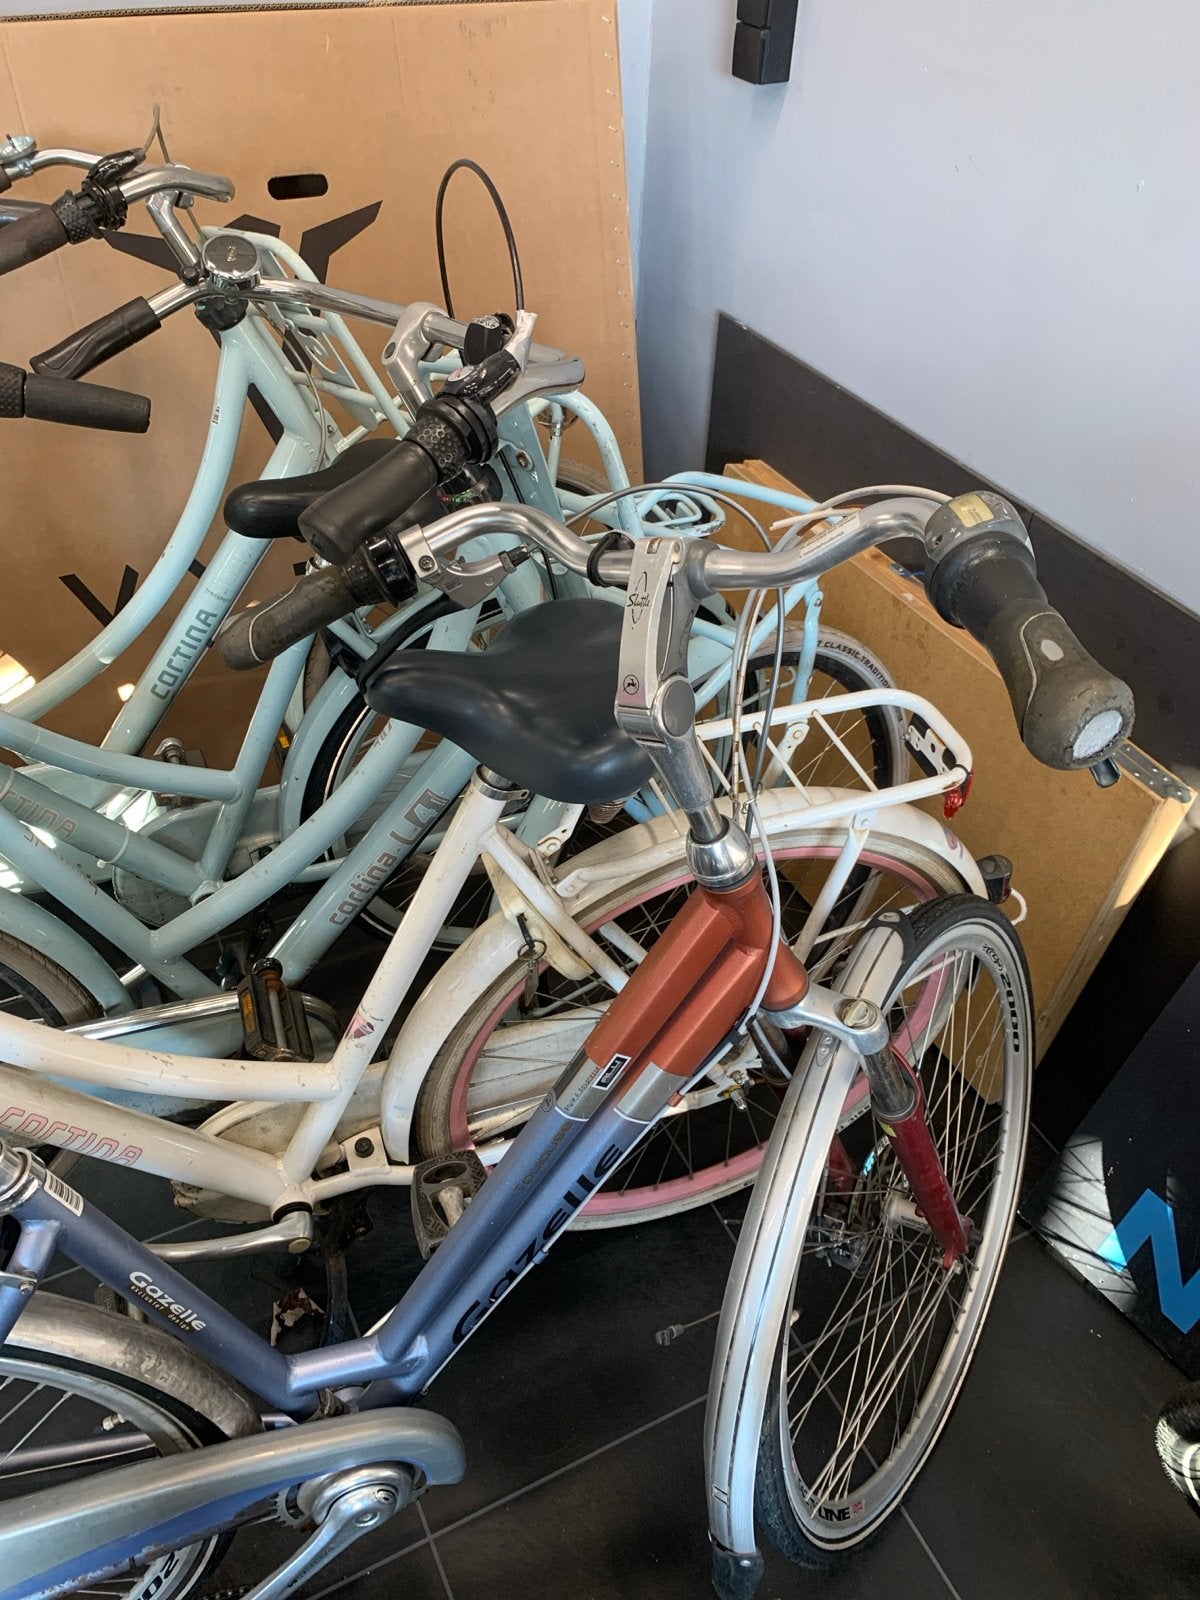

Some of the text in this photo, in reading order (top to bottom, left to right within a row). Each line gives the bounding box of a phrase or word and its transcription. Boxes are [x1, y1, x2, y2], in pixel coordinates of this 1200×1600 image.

[328, 851, 399, 926] cortina
[1000, 972, 1020, 1053] 2000
[129, 1271, 207, 1331] Gazelle
[167, 1313, 190, 1332] design
